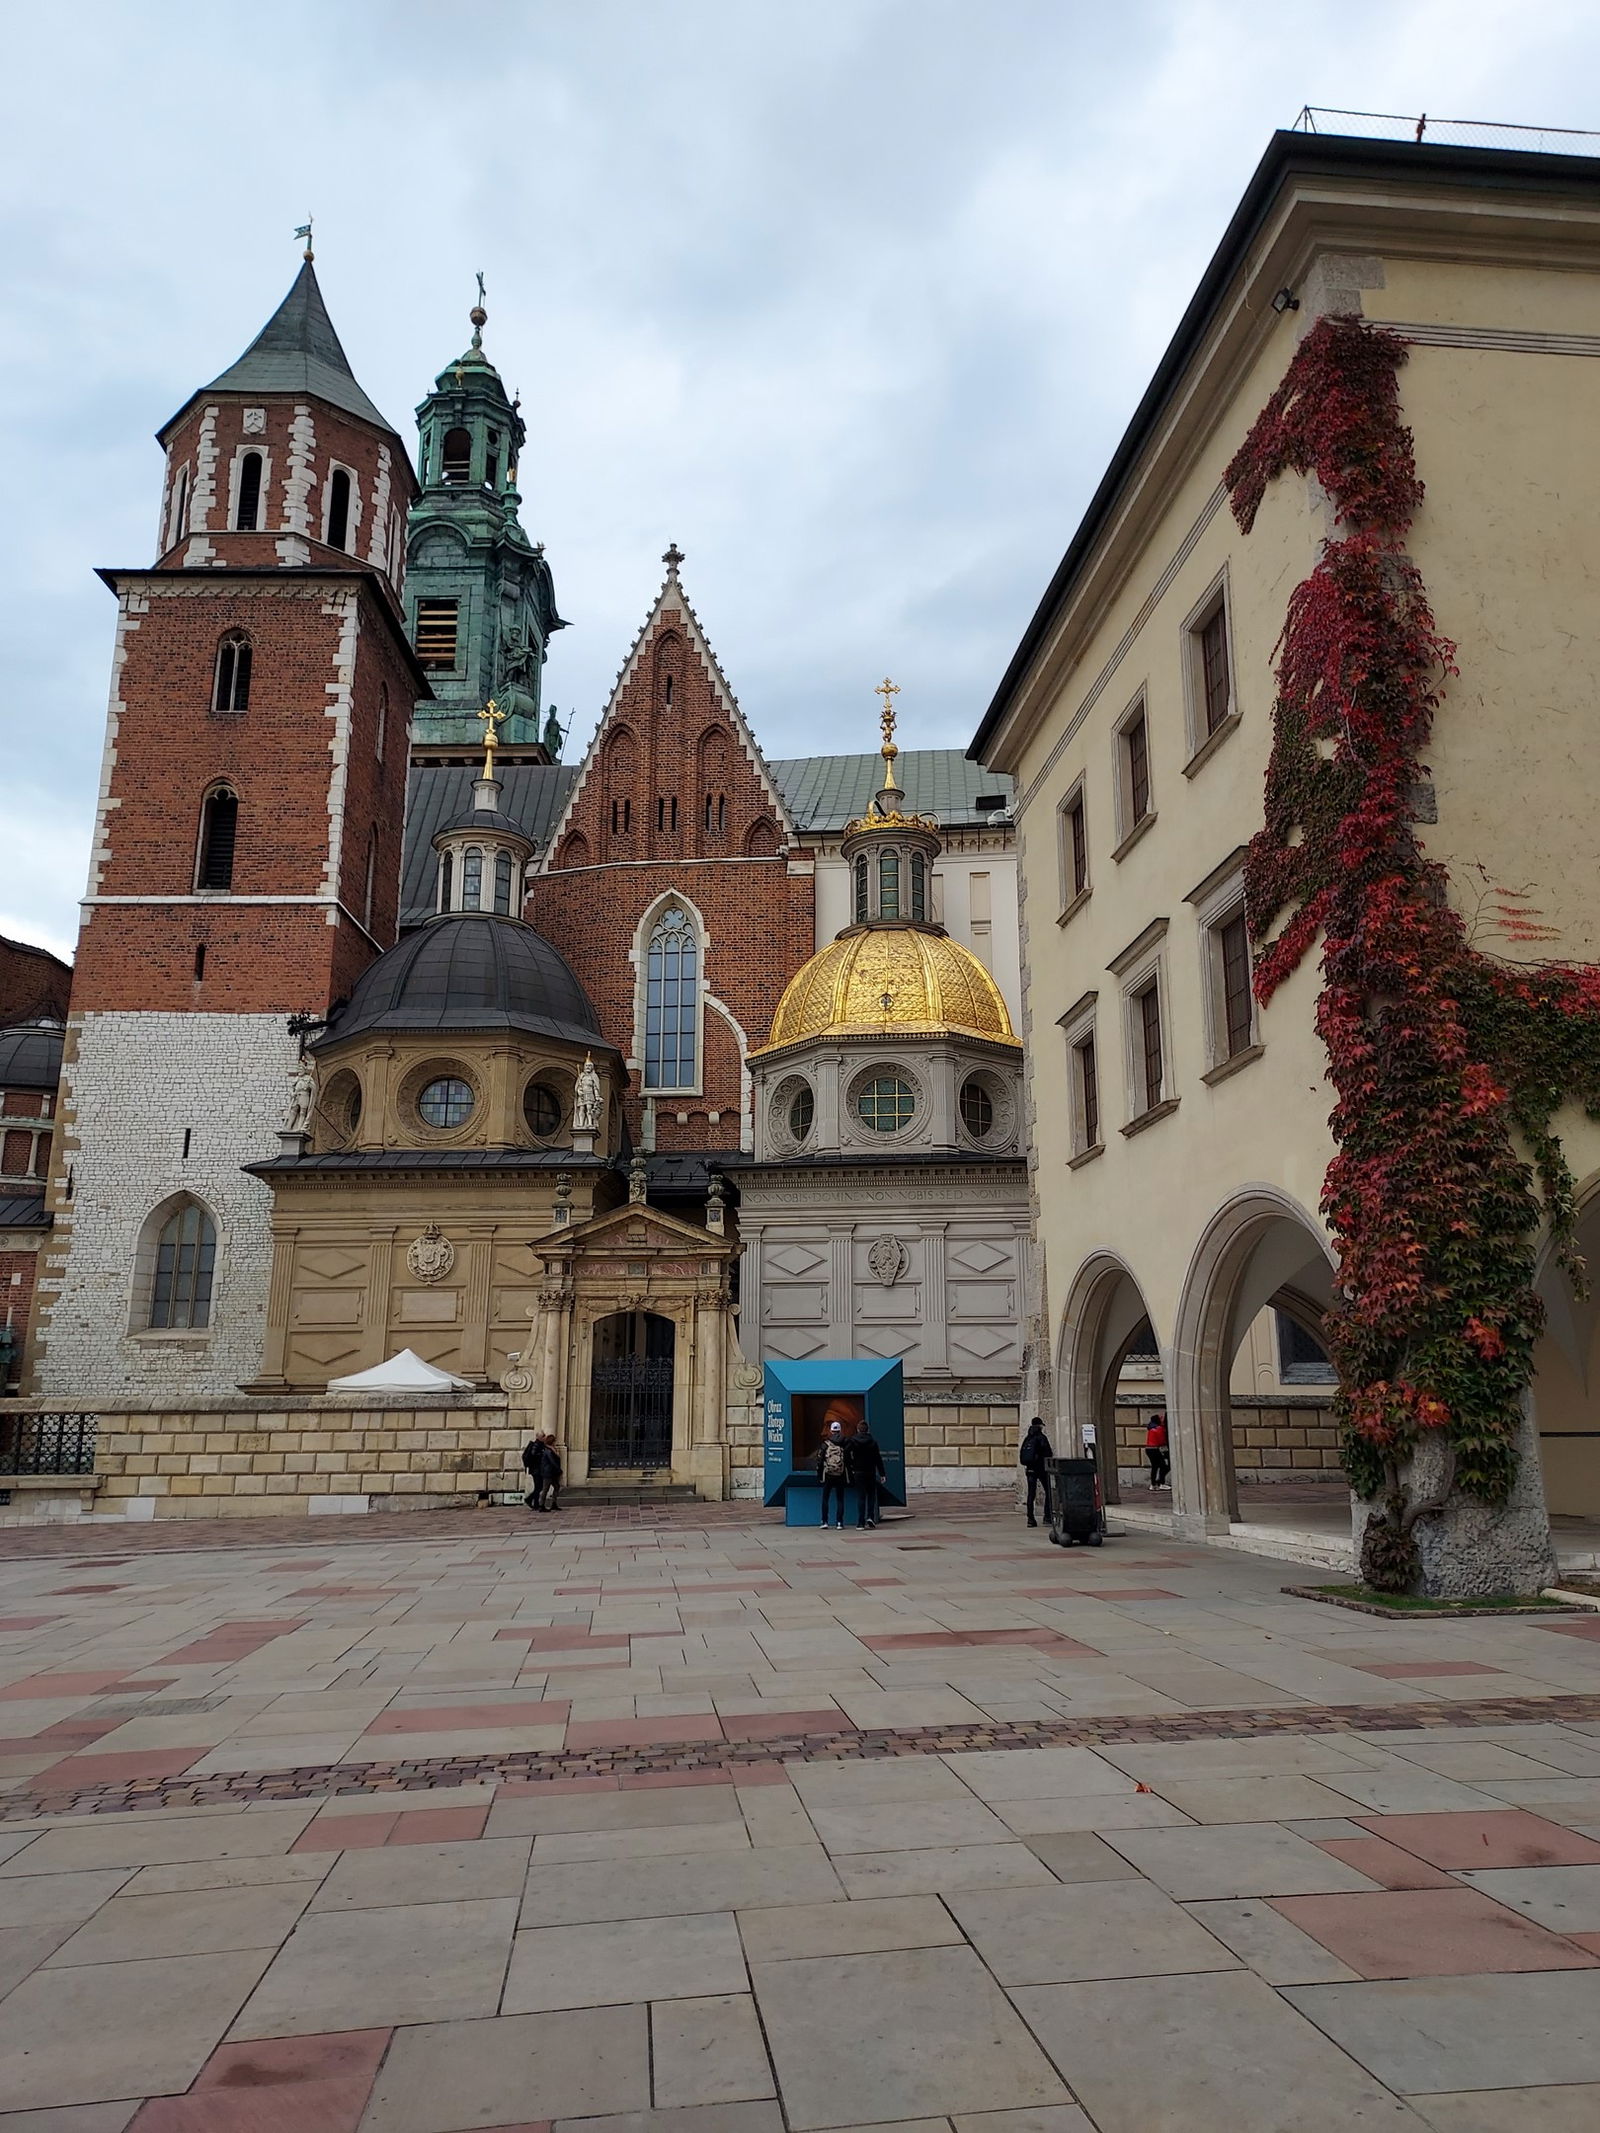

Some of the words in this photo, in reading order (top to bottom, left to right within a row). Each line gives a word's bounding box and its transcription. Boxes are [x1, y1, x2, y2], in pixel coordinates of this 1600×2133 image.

[744, 1193, 770, 1204] NON
[775, 1192, 808, 1203] NOBIS
[866, 1191, 893, 1201] NON
[898, 1190, 934, 1201] NOBIS
[939, 1189, 963, 1200] SED
